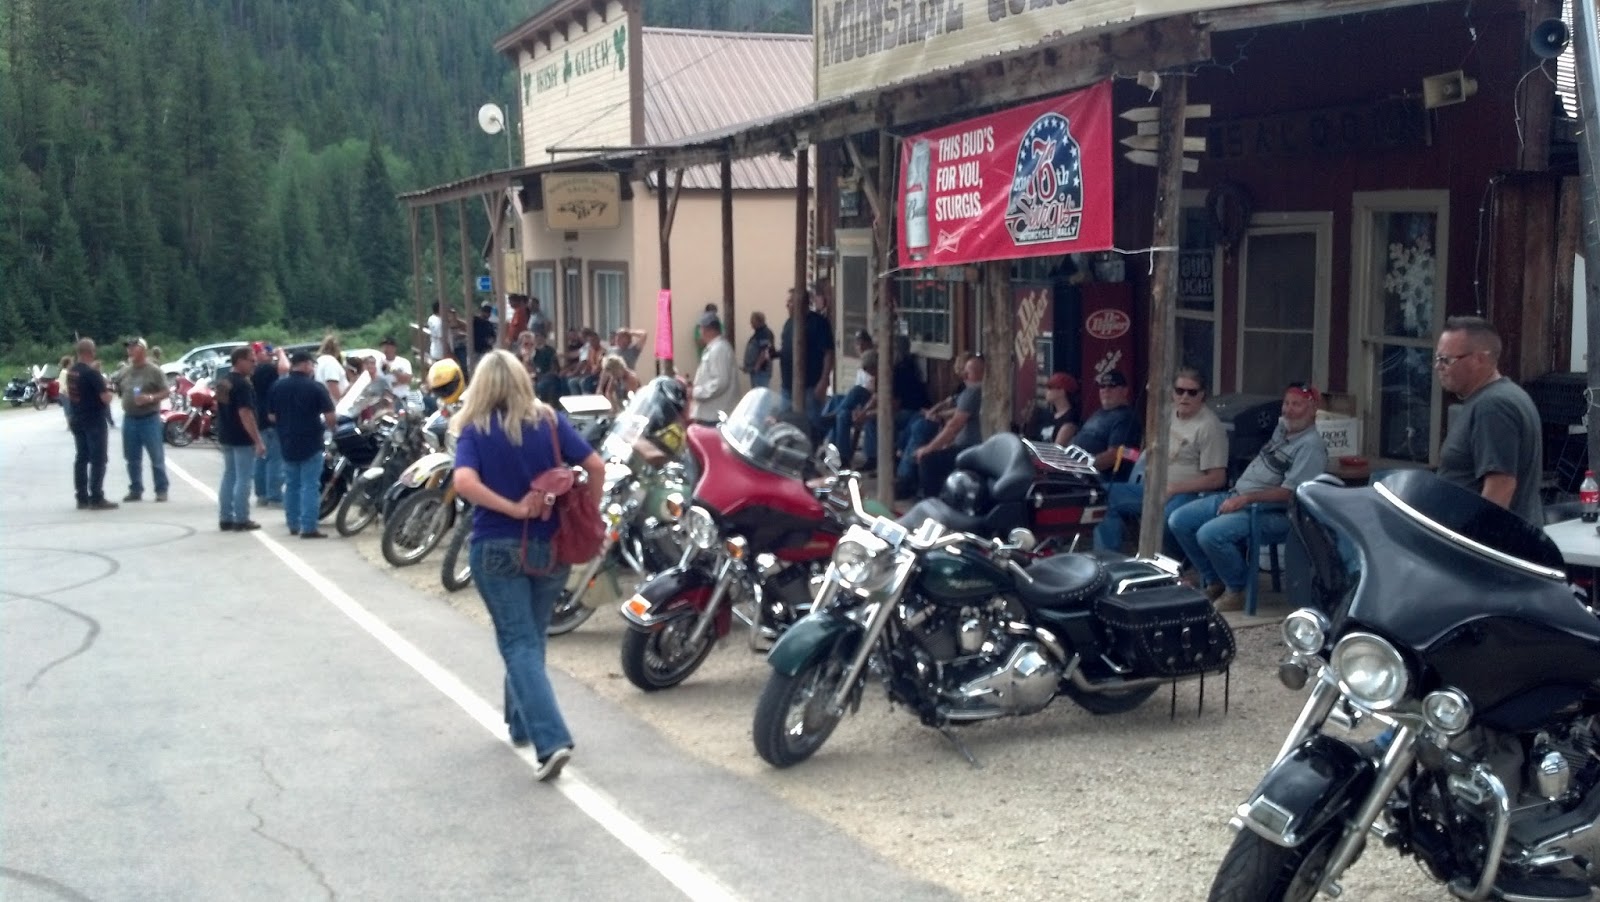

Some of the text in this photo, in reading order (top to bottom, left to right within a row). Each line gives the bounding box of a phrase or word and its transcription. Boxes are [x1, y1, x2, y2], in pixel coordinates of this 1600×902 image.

[536, 39, 611, 93] IRISH GULCH
[938, 126, 995, 163] THIS BUD'S
[936, 160, 983, 192] FOR YOU,
[936, 191, 983, 222] STURGIS.
